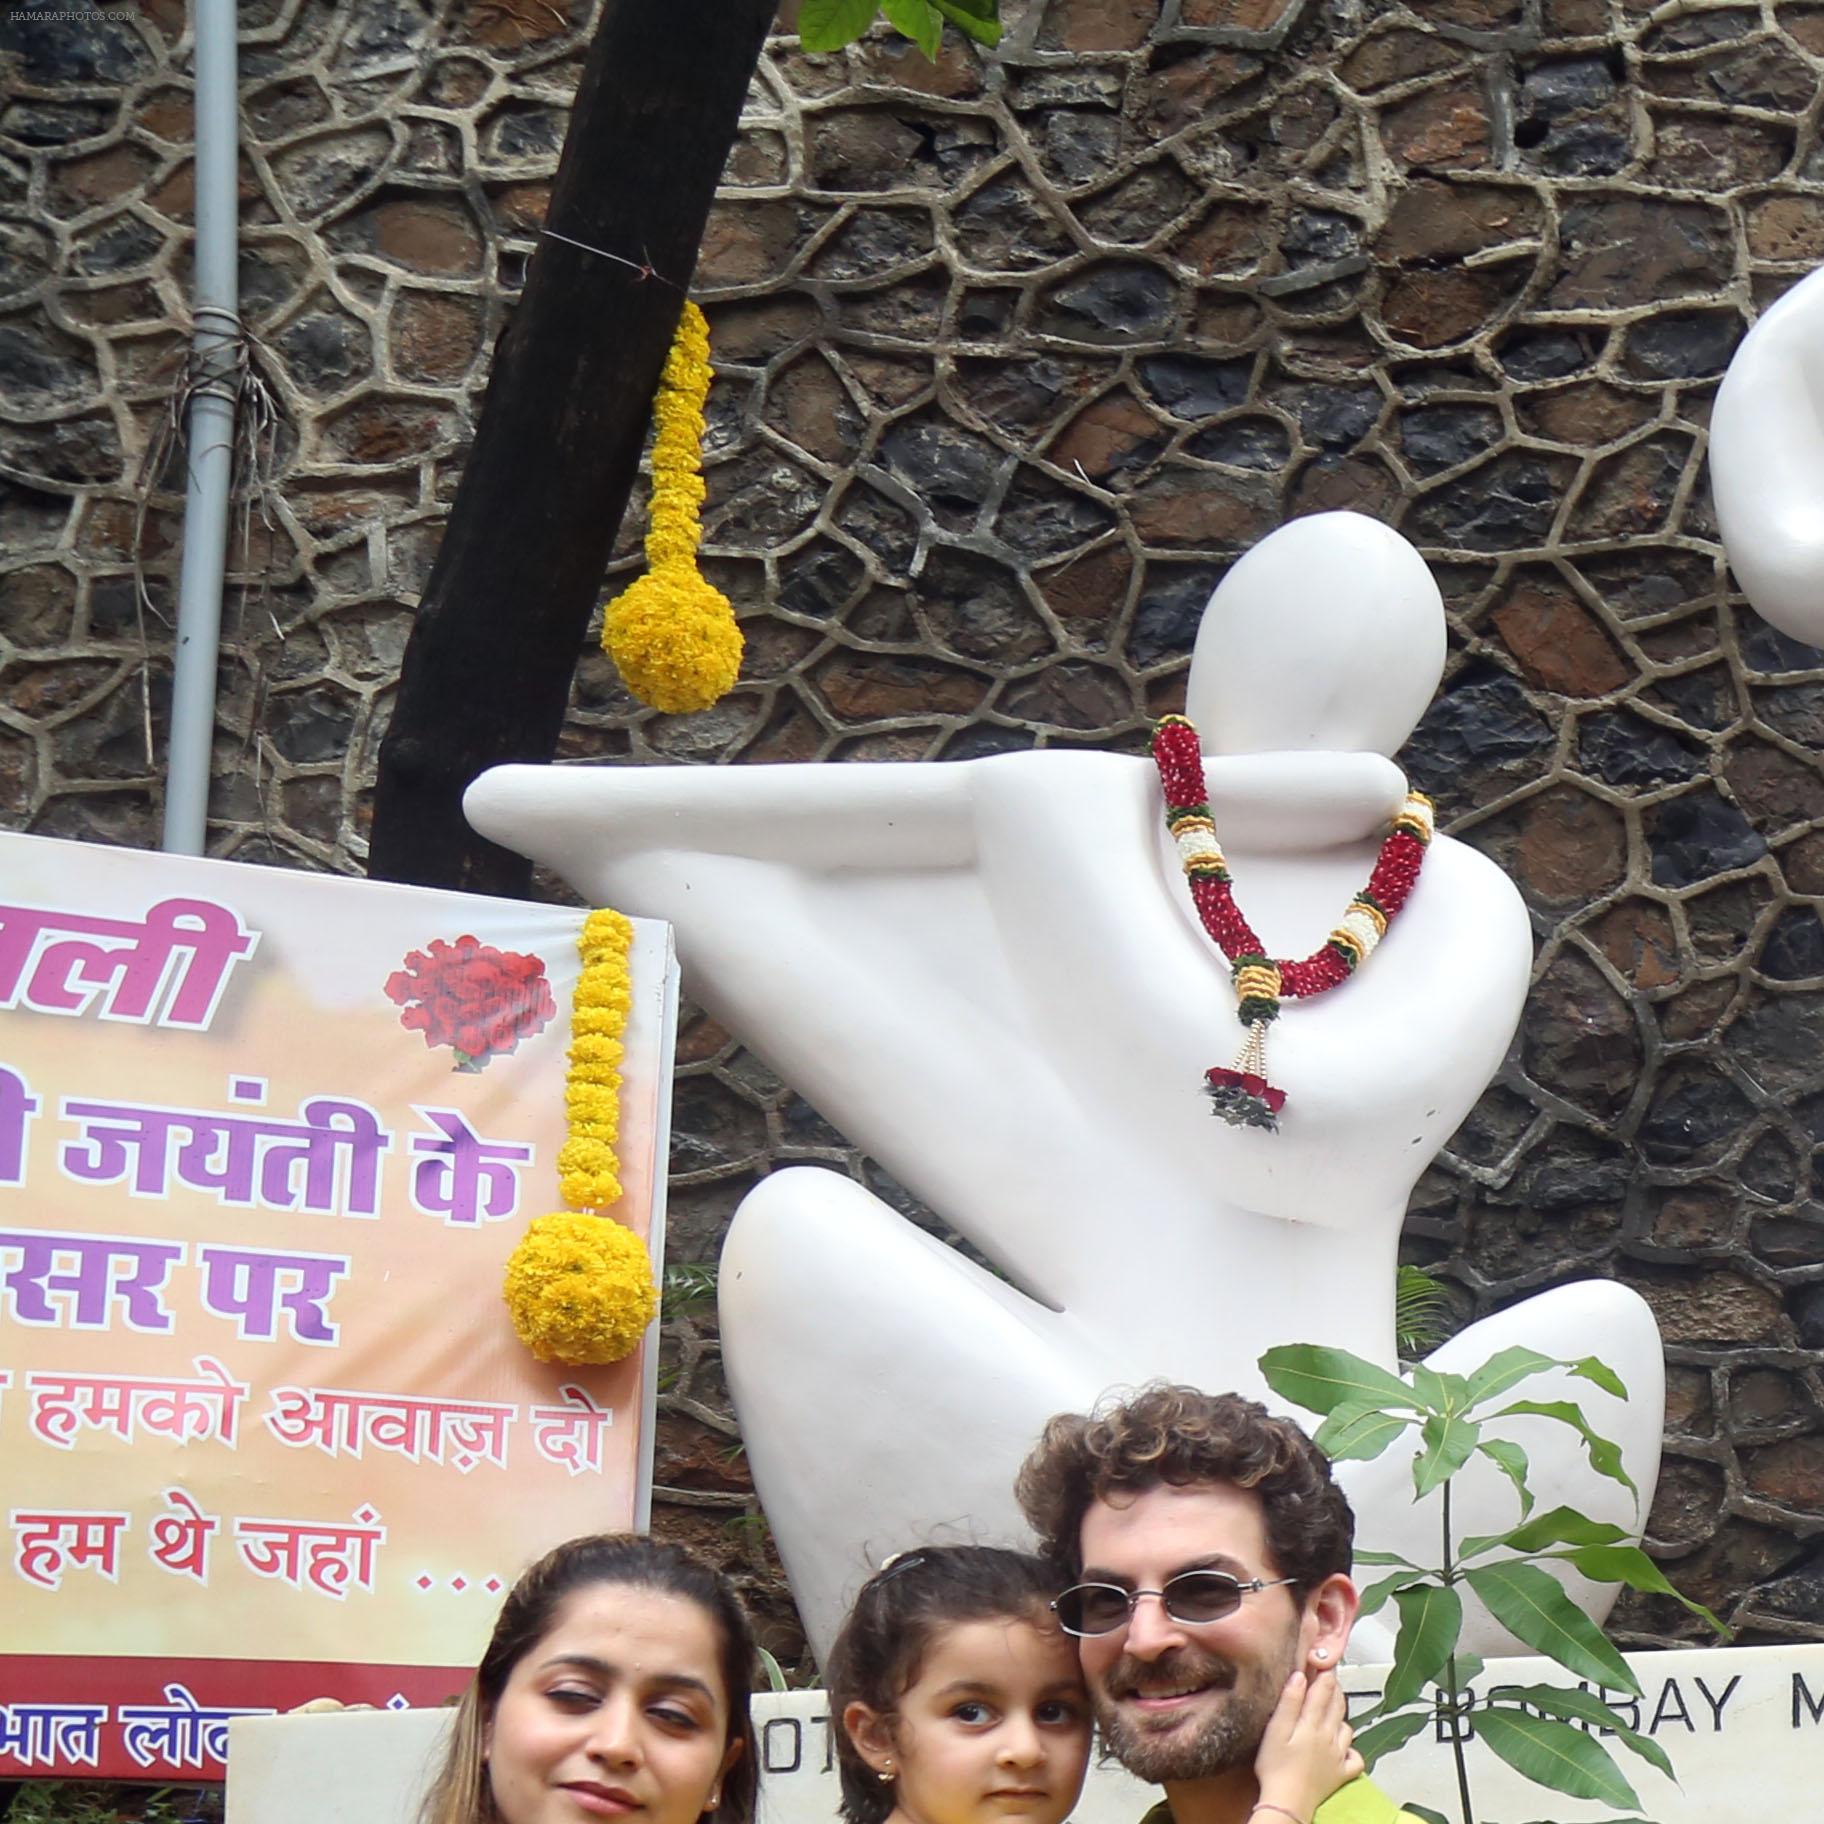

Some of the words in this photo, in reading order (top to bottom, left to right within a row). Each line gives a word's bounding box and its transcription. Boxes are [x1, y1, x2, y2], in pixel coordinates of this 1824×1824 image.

[59, 1074, 395, 1218] जयंती
[406, 1104, 534, 1228] के
[197, 1241, 352, 1347] पर
[25, 1355, 250, 1450] हमको
[530, 1382, 612, 1476] दो
[10, 1509, 131, 1592] हम
[149, 1486, 221, 1588] थे
[233, 1503, 387, 1601] जहां
